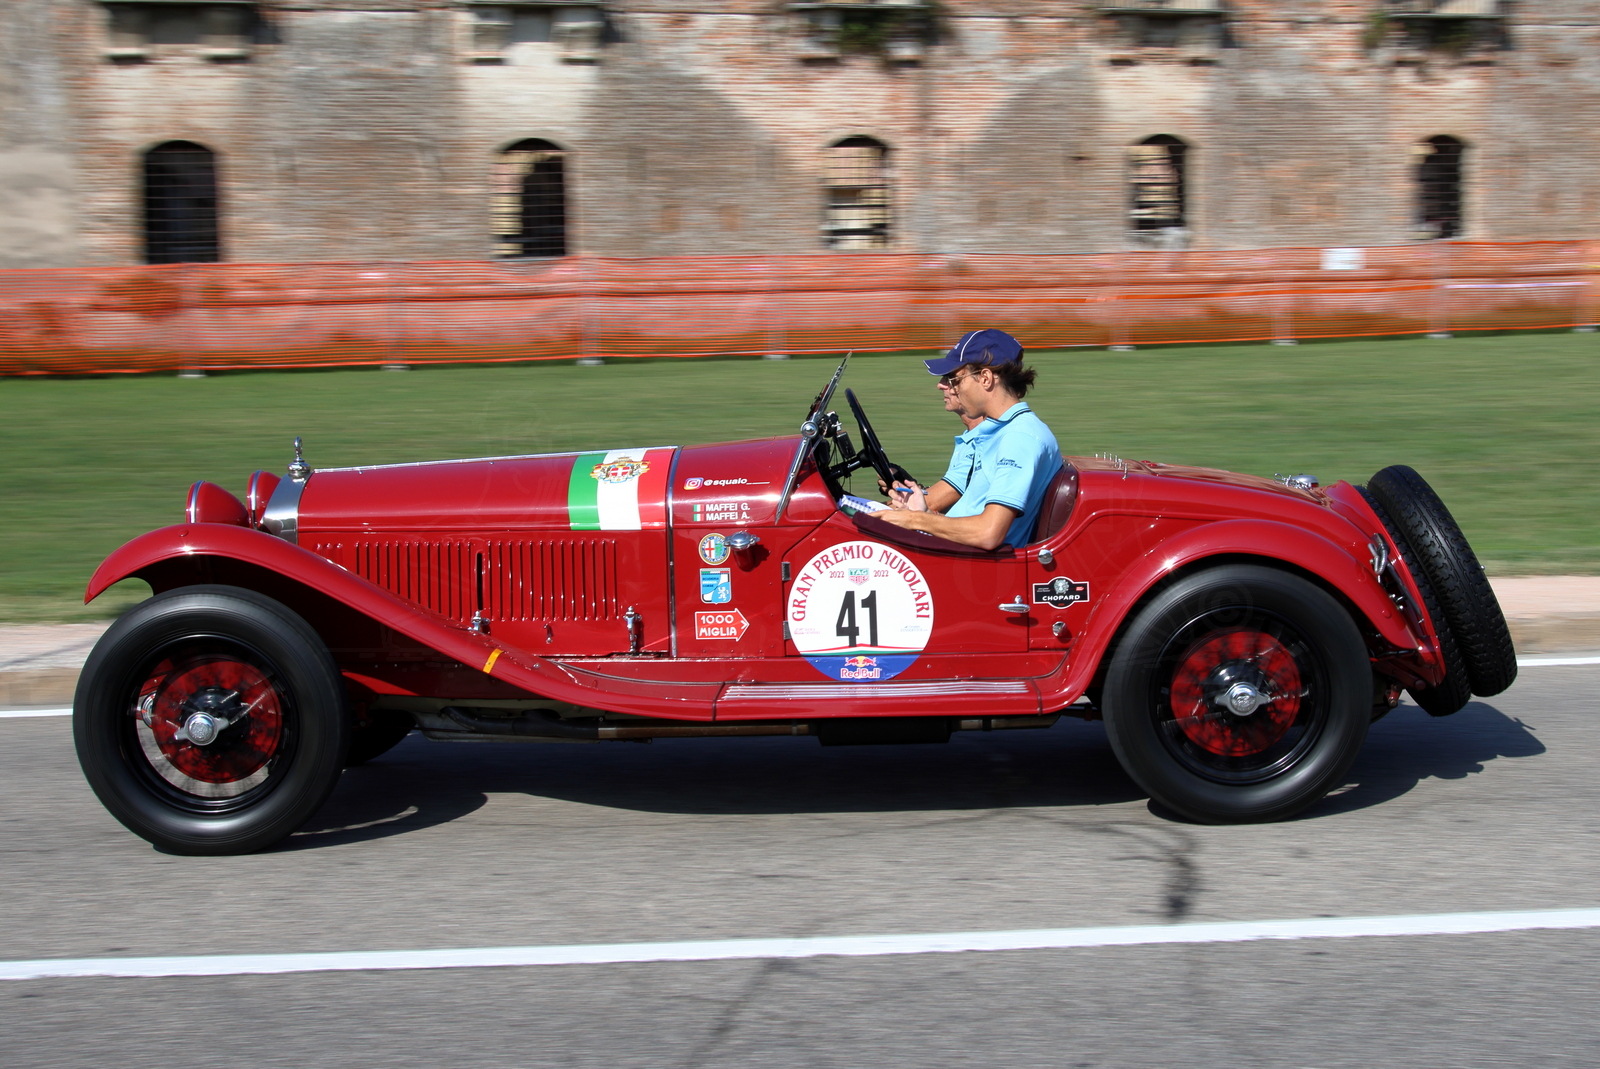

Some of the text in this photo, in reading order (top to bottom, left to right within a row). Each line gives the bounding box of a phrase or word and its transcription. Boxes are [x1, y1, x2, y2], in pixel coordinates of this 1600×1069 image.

[705, 502, 751, 512] MAFFEI G.
[706, 511, 751, 521] MAFFEI A.
[829, 570, 845, 579] 2022
[873, 569, 889, 578] 2022
[792, 573, 816, 622] GRAN
[812, 545, 873, 575] PREMIO
[879, 549, 930, 619] NUVOLARI
[701, 614, 734, 624] 1000
[836, 590, 878, 647] 41
[699, 627, 737, 637] MIGLIA
